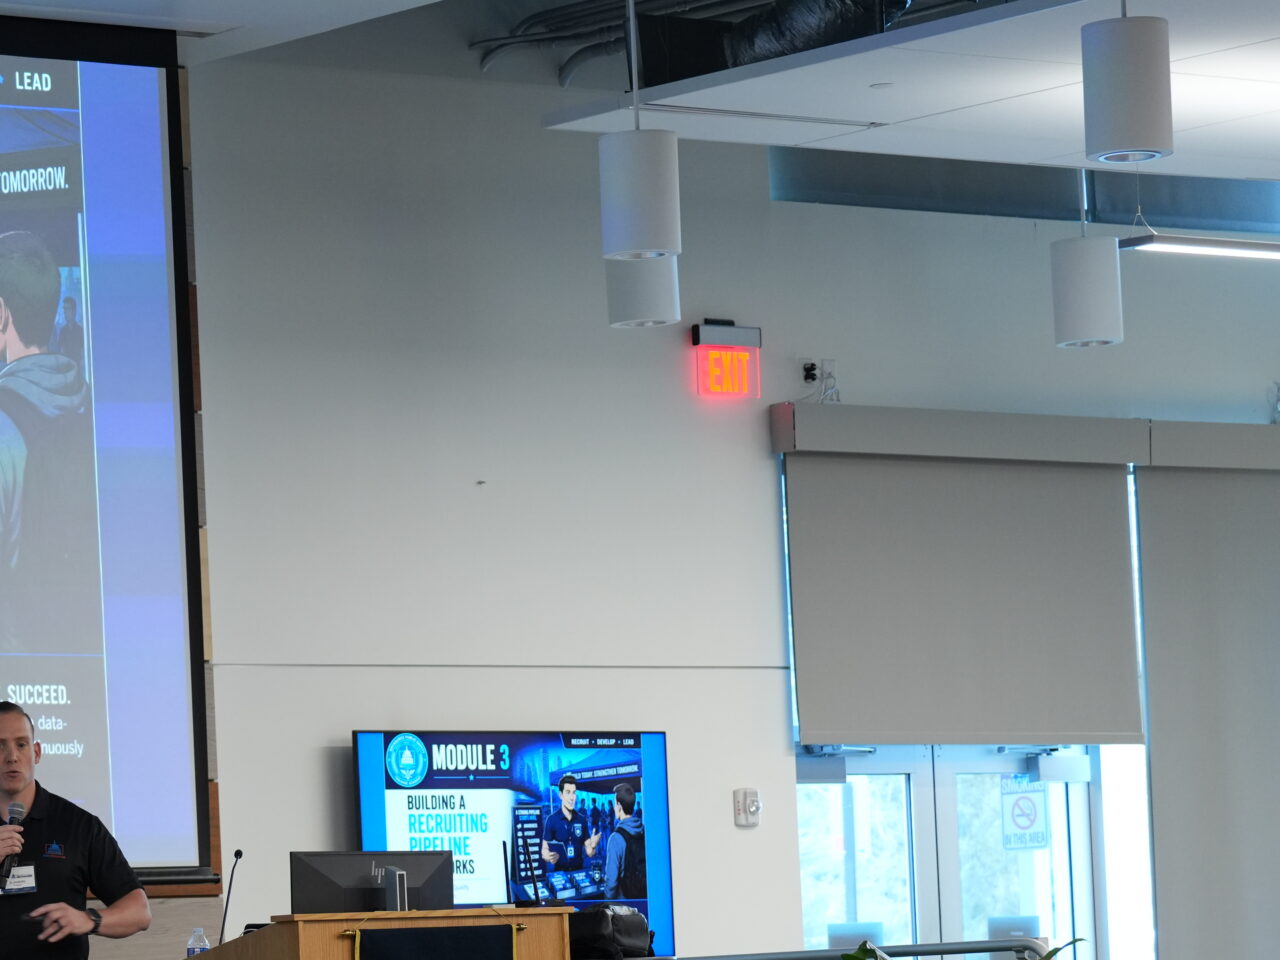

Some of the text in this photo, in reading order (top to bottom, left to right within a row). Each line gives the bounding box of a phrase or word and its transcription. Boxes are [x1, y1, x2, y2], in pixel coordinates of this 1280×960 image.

[15, 71, 52, 93] LEAD
[709, 351, 749, 392] EXIT
[8, 684, 71, 704] SUCCEED.
[38, 715, 67, 731] data-
[432, 744, 509, 771] MODULE 3
[407, 795, 466, 810] BUILDING A
[408, 813, 488, 833] RECRUITING
